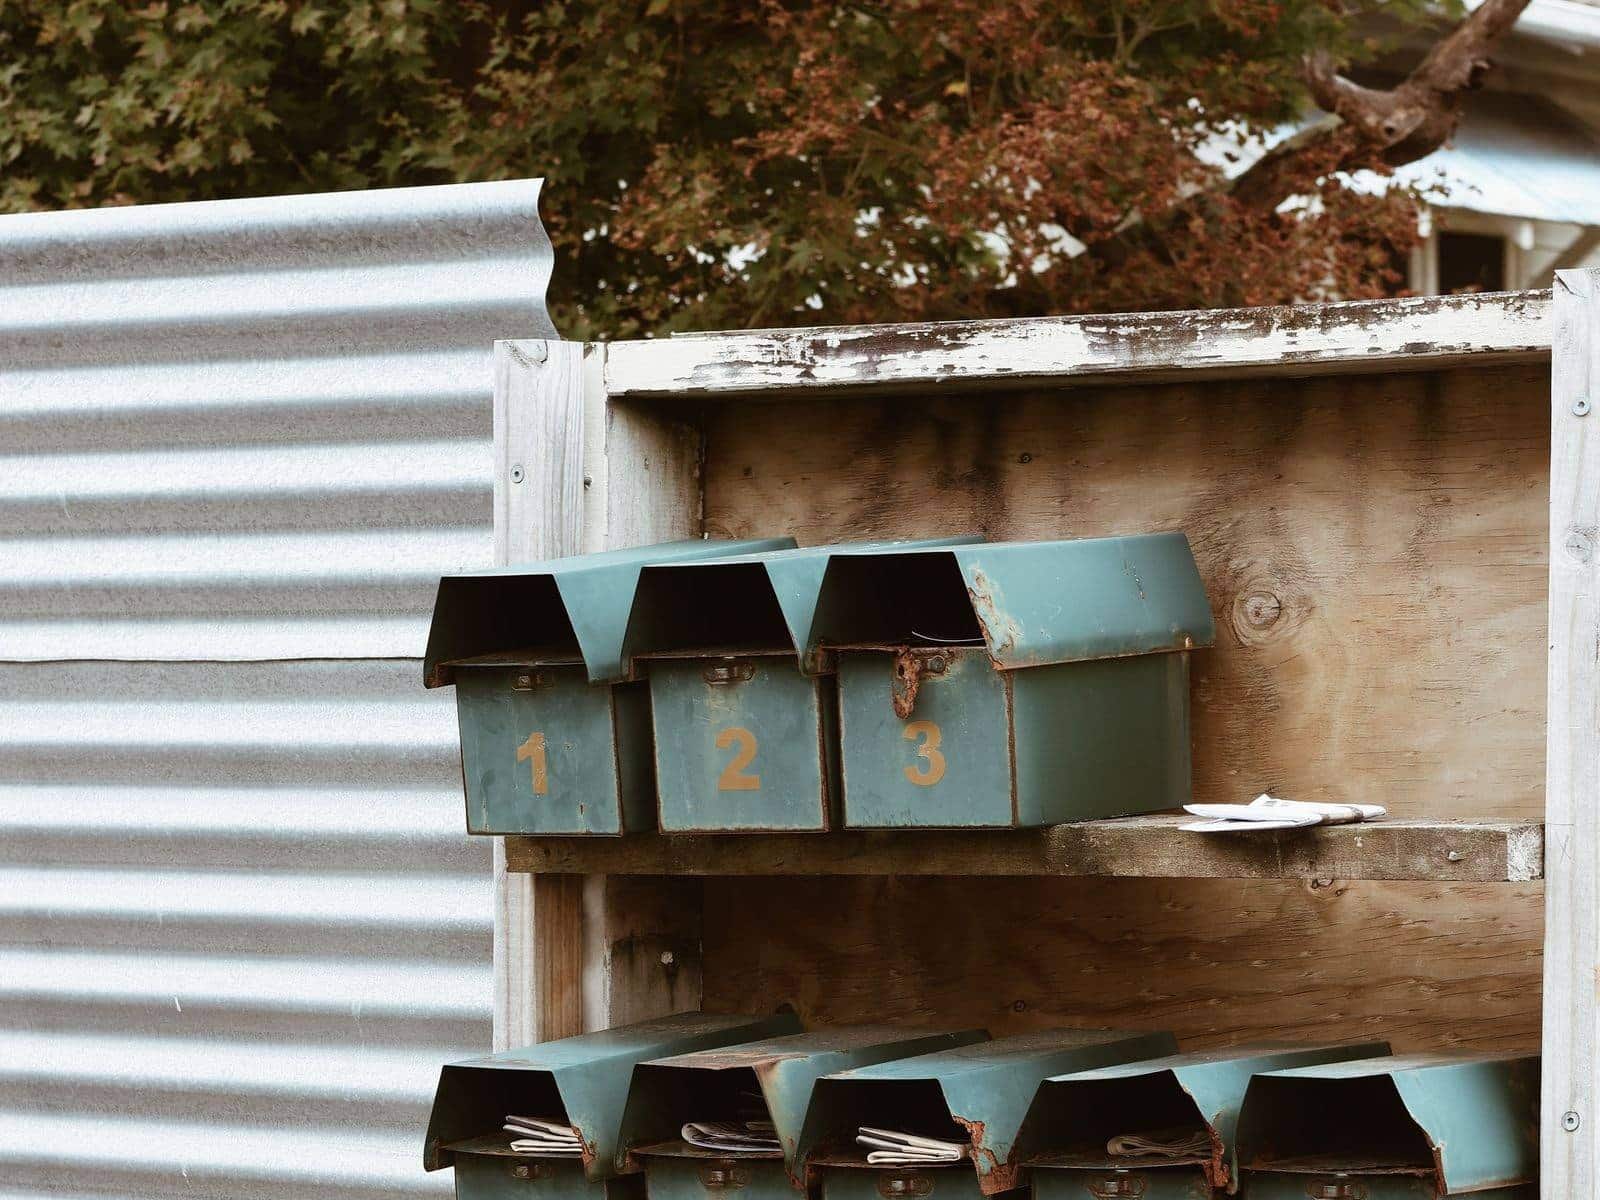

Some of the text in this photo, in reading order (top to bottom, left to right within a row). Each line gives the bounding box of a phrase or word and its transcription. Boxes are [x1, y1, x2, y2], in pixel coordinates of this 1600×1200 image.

[517, 732, 547, 795] 1
[716, 728, 760, 791] 2
[904, 720, 946, 785] 3
